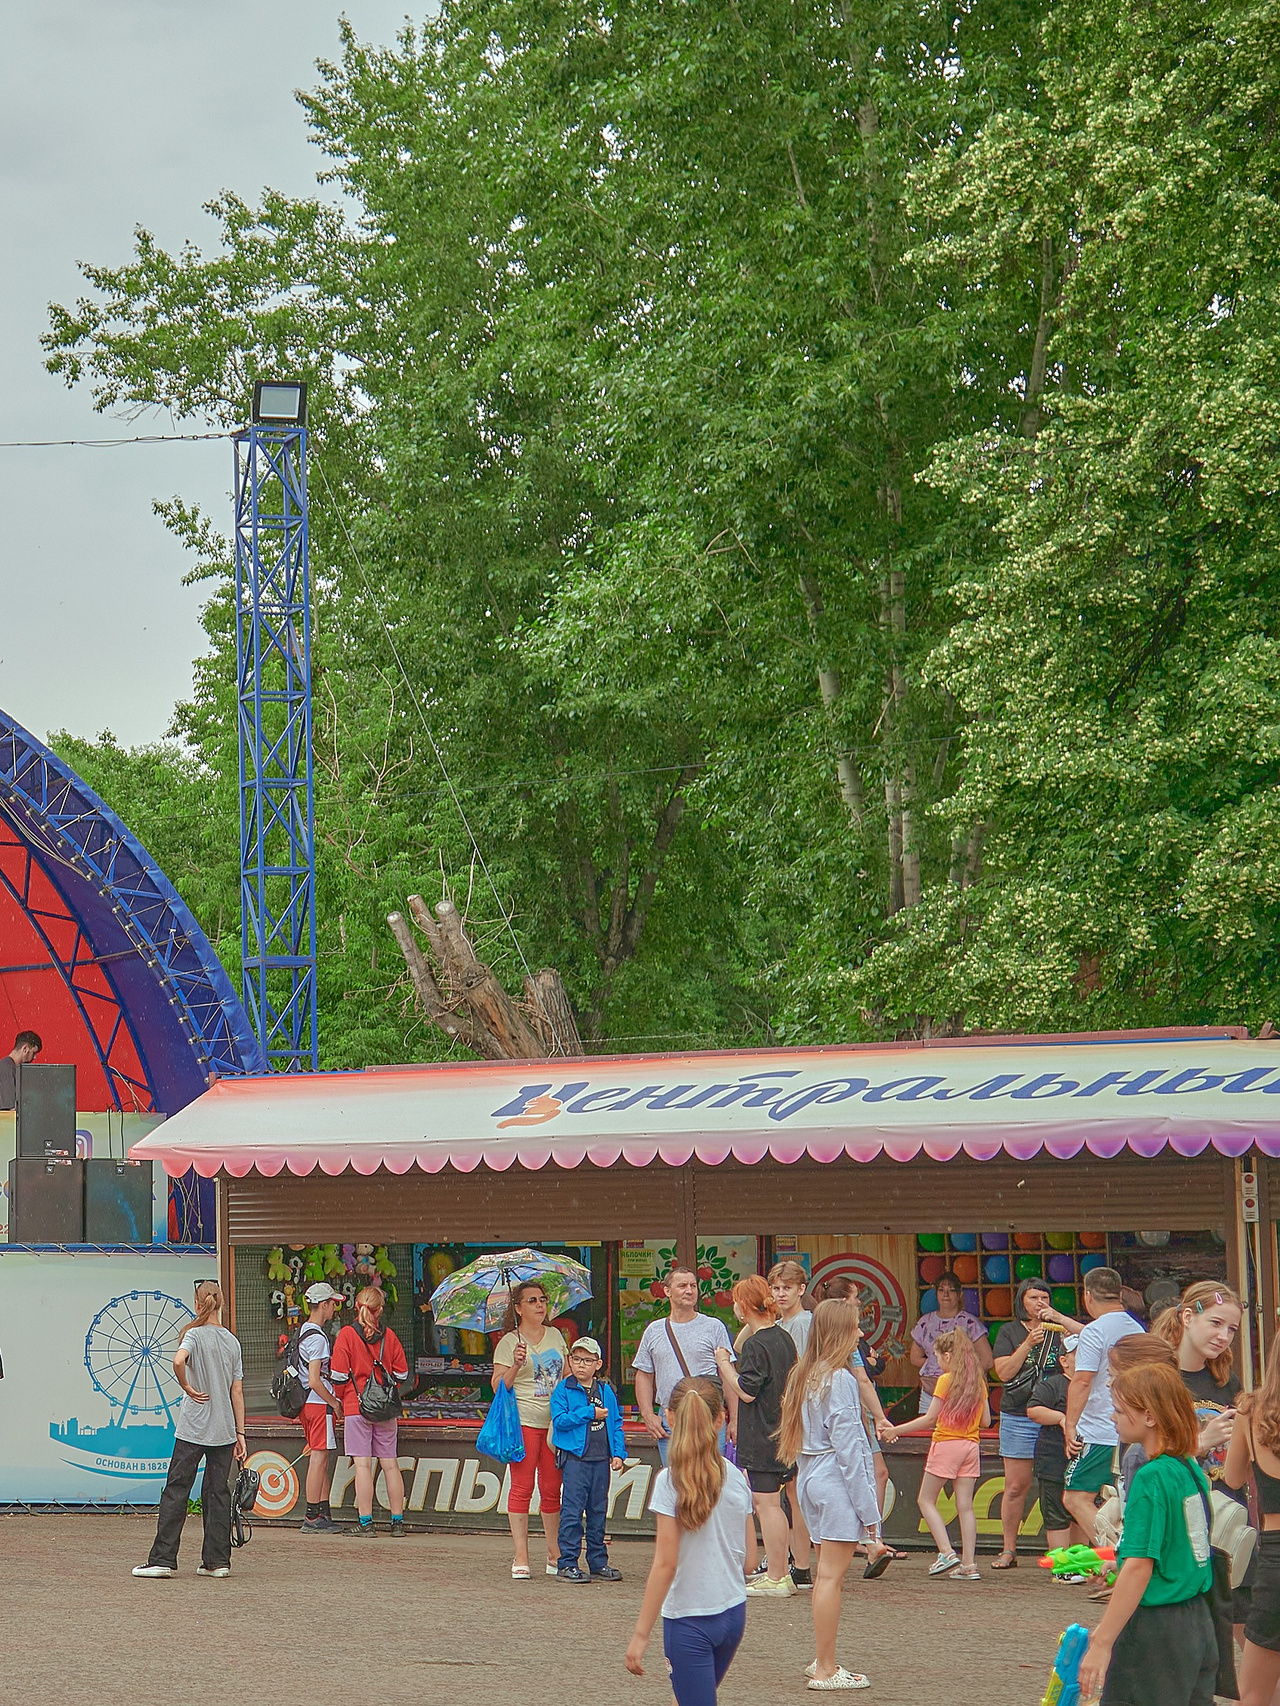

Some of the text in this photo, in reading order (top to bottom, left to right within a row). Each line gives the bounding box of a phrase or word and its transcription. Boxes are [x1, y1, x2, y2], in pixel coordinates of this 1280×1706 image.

[491, 1067, 1280, 1122] Центральны
[95, 1457, 168, 1471] ОСНОВАН В 1828
